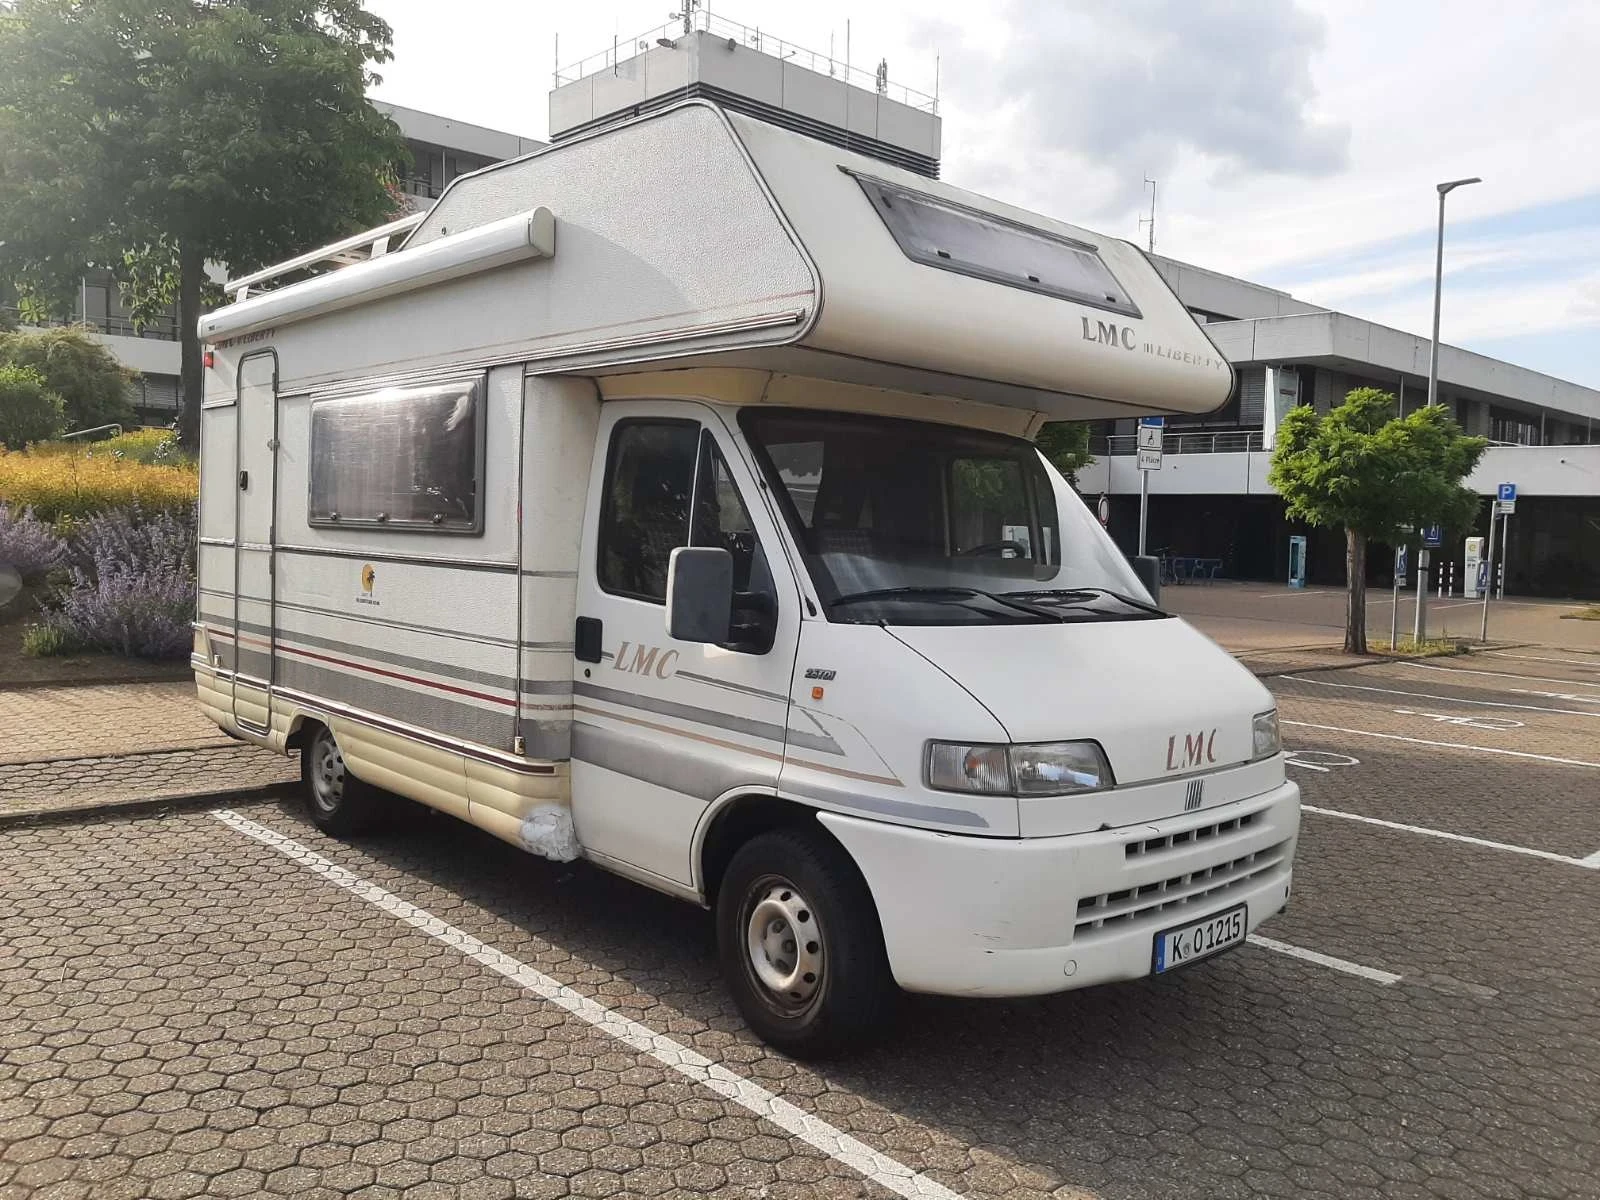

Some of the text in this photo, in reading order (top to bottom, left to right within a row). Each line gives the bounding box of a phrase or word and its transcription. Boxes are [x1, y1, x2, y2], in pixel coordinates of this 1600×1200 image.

[1081, 316, 1223, 369] LMC LIBERTY
[1502, 486, 1512, 498] P
[614, 641, 679, 680] LMC
[1166, 728, 1216, 770] LMC
[1172, 933, 1183, 962] K
